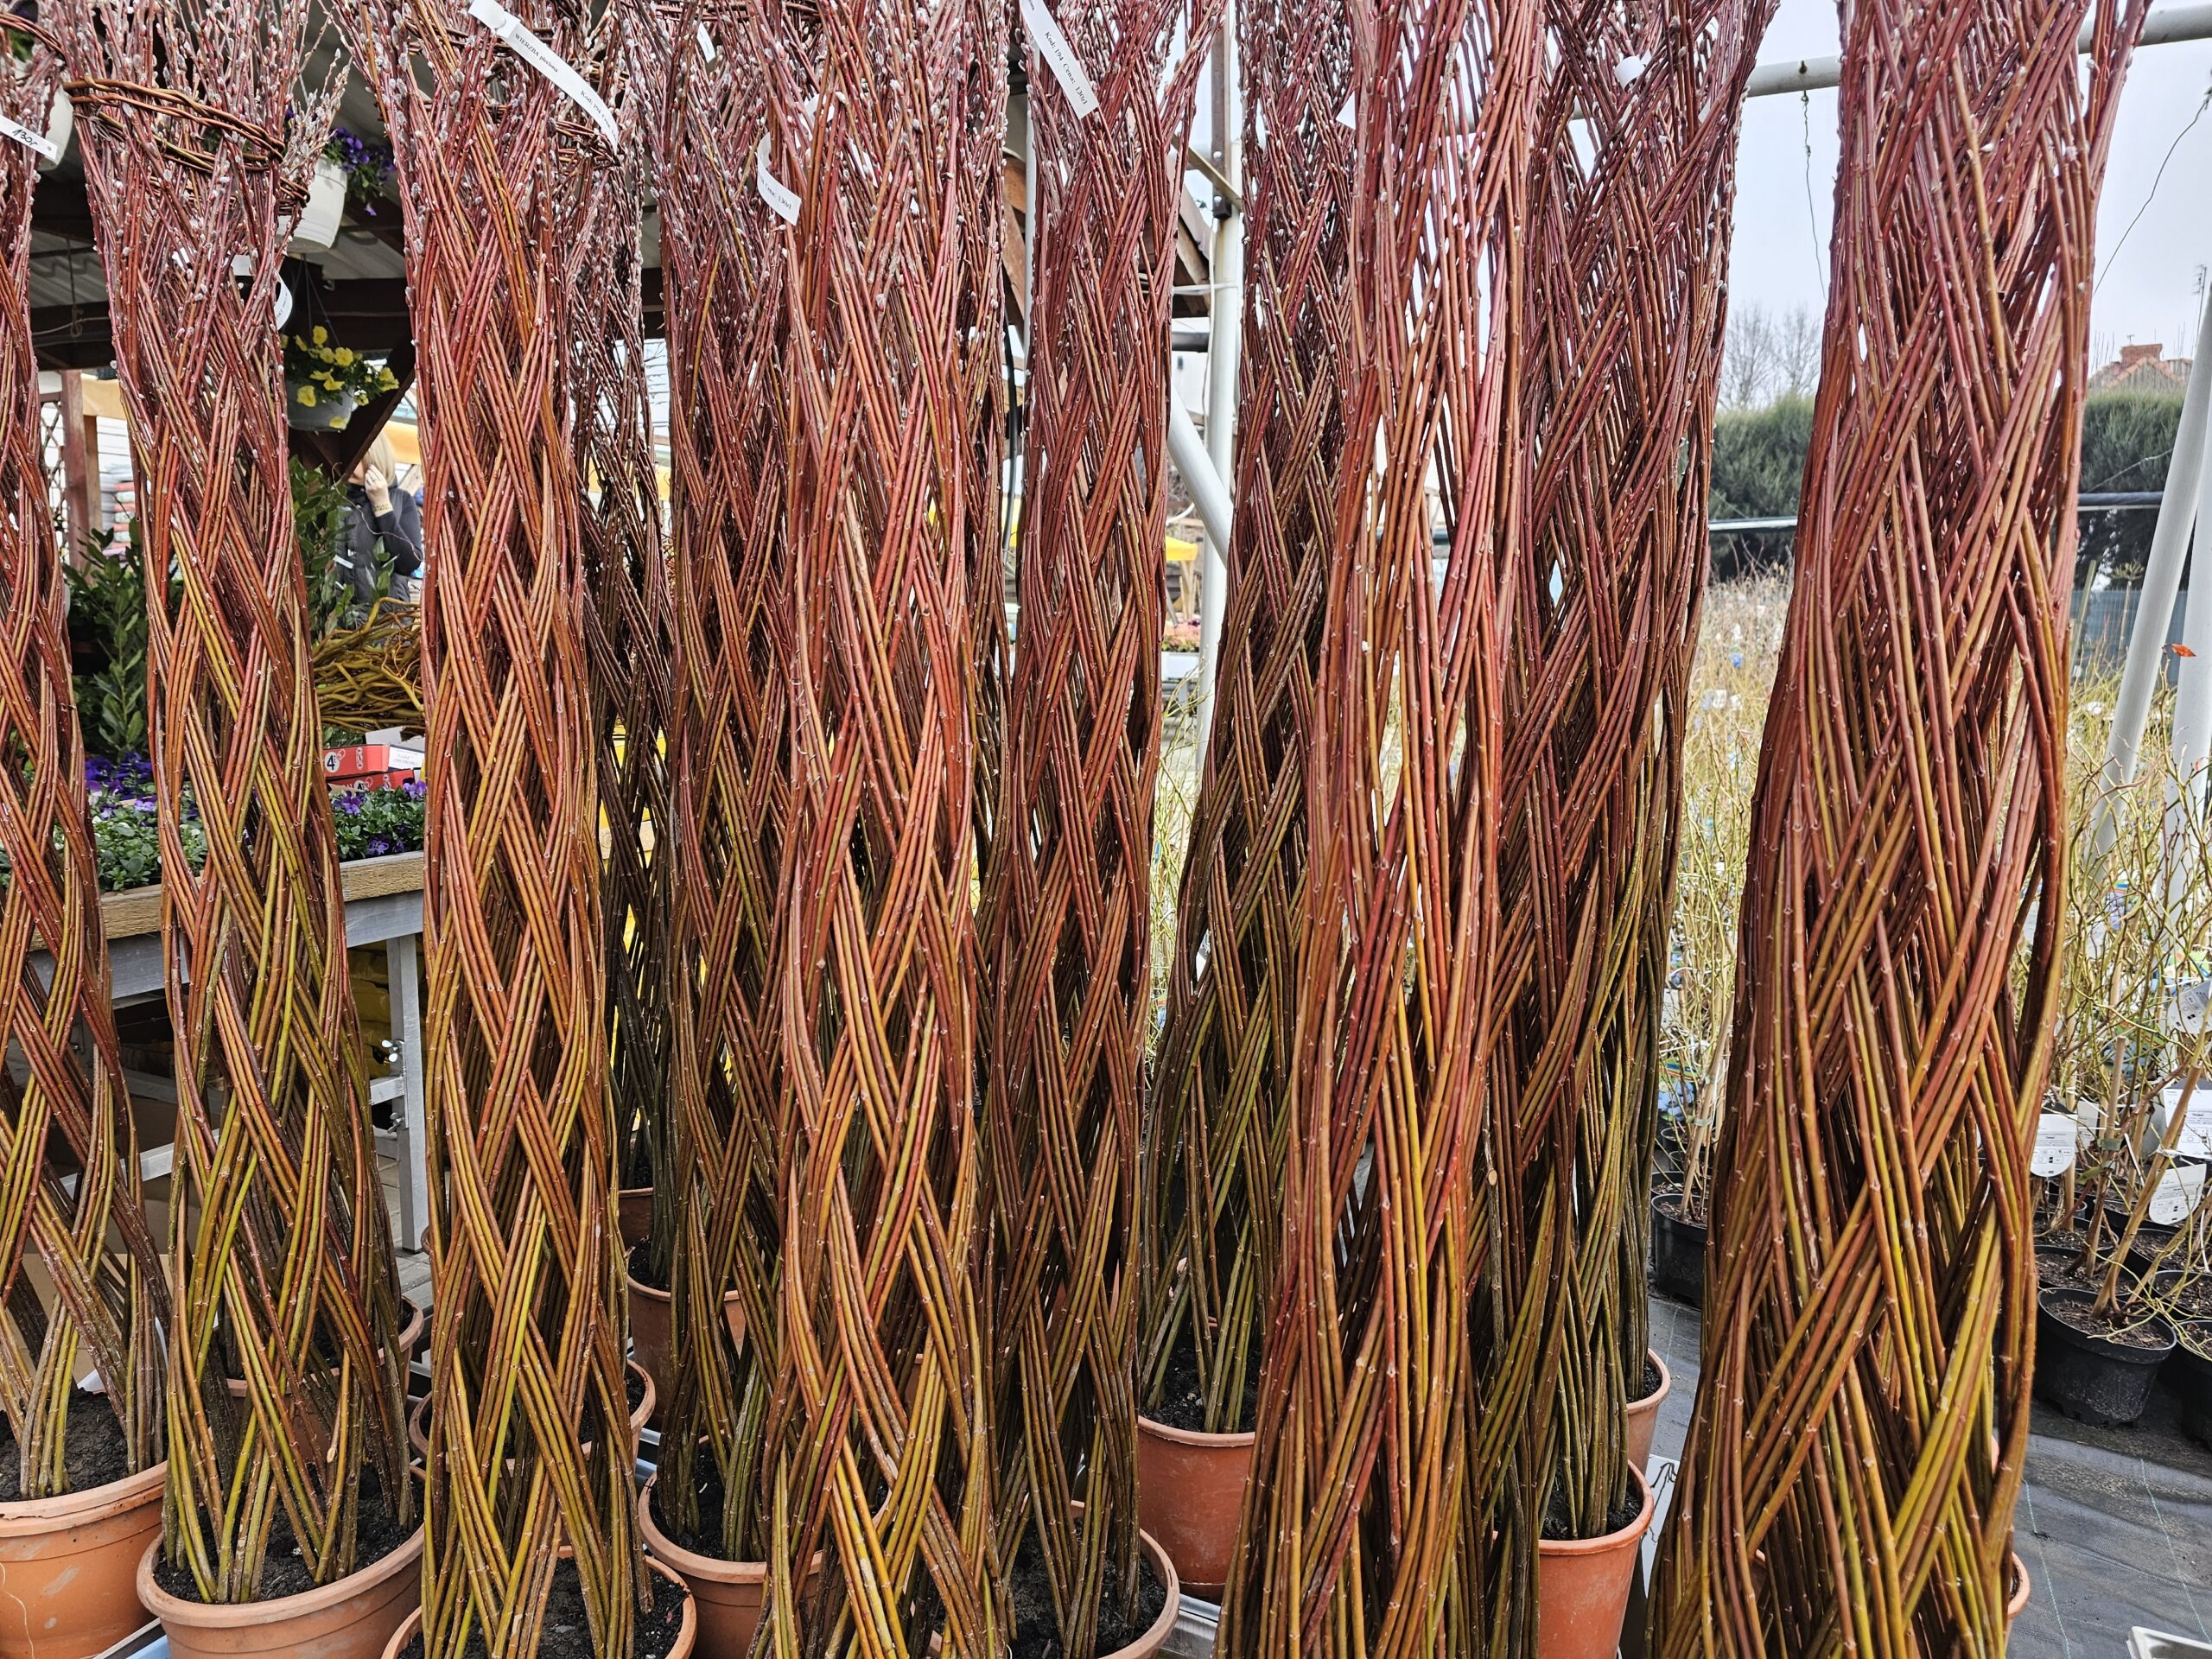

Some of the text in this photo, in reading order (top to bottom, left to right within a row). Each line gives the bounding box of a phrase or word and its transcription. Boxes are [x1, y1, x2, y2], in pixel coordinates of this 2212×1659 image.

[515, 33, 540, 57] WIERZBA
[1044, 31, 1056, 48] Kod:
[1054, 48, 1065, 61] 194
[1063, 63, 1076, 84] Cena:
[327, 754, 335, 770] 4
